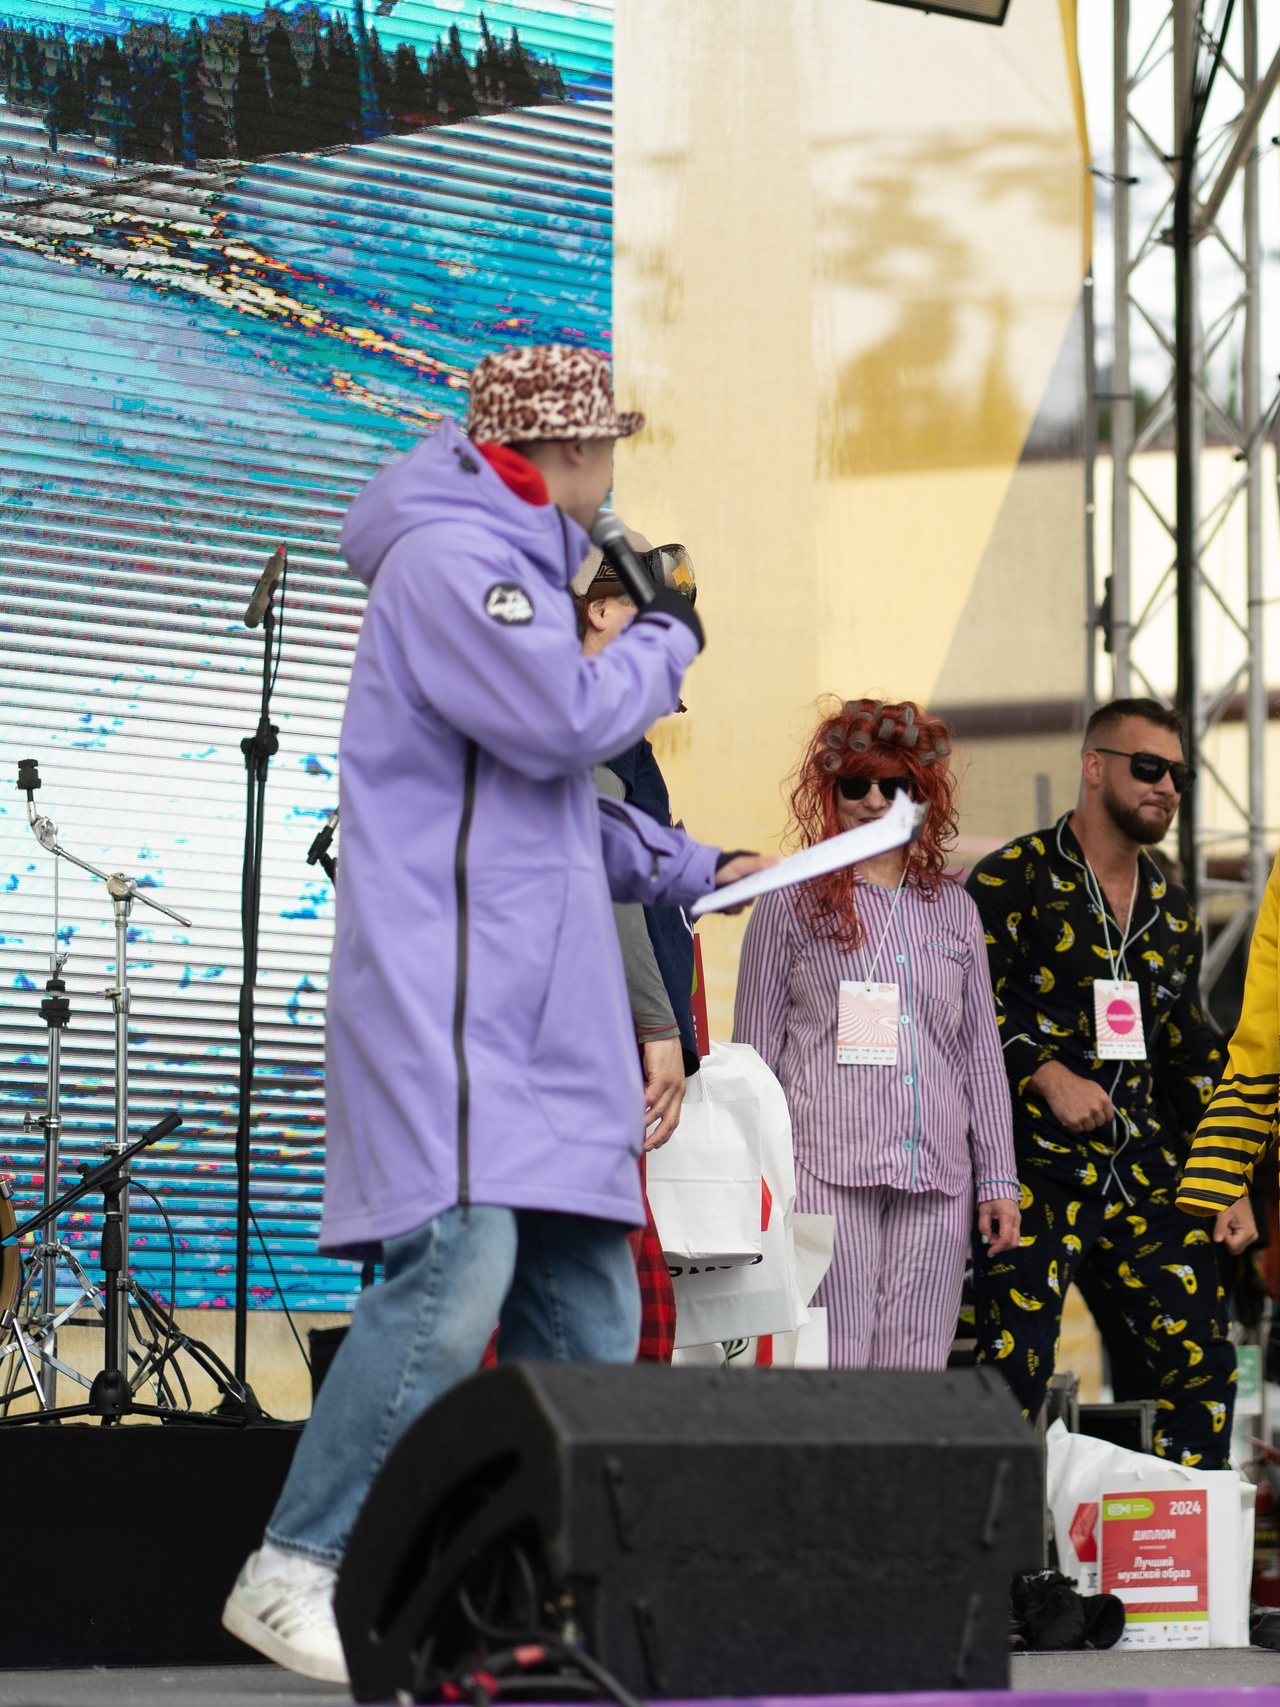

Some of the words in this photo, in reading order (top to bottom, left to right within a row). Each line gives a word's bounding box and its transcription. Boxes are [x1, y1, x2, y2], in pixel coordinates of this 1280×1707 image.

[1169, 1500, 1203, 1516] 2024
[1132, 1529, 1176, 1541] ДИПЛОМ
[1133, 1556, 1174, 1570] Лучший
[1117, 1569, 1161, 1583] мужской
[1162, 1568, 1191, 1581] образ
